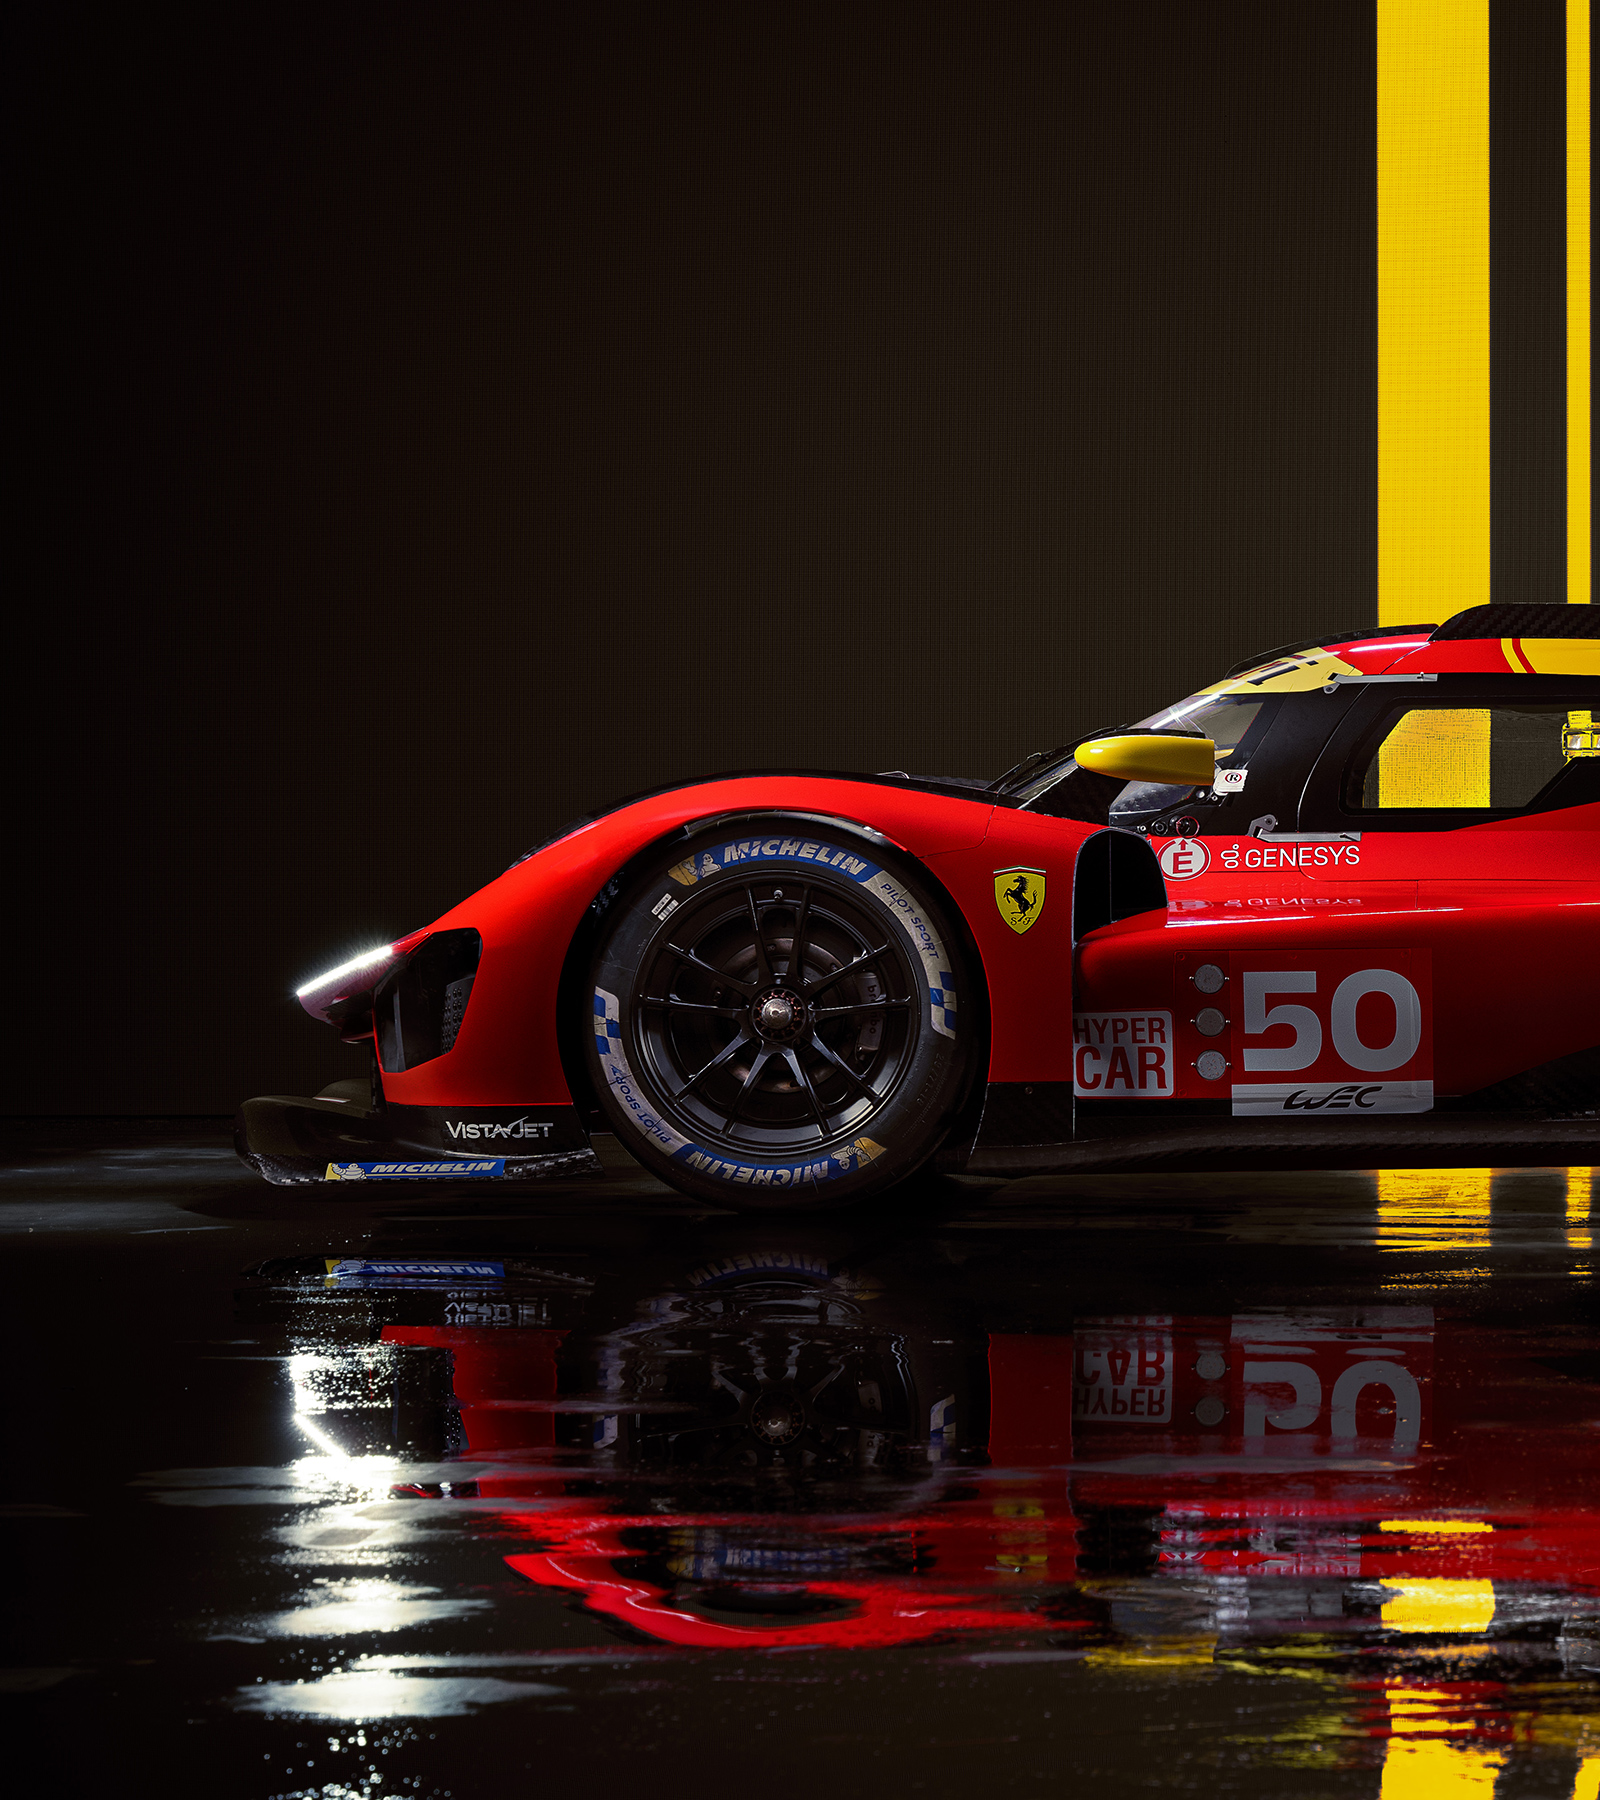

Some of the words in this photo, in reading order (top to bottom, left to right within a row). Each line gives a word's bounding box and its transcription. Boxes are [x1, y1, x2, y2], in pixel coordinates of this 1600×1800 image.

[723, 838, 868, 876] MICHELIN
[1172, 851, 1193, 874] E
[1245, 845, 1360, 868] GENESYS
[880, 882, 914, 916] PILOT
[911, 916, 939, 960] SPORT
[1074, 1017, 1167, 1044] HYPER
[1243, 969, 1422, 1072] 50
[1075, 1045, 1168, 1090] CAR
[610, 1063, 643, 1112] SPORT
[1283, 1086, 1383, 1110] WEC
[635, 1111, 669, 1144] PILOT
[371, 1161, 497, 1174] MICHELIN
[684, 1150, 829, 1187] MICHELIN
